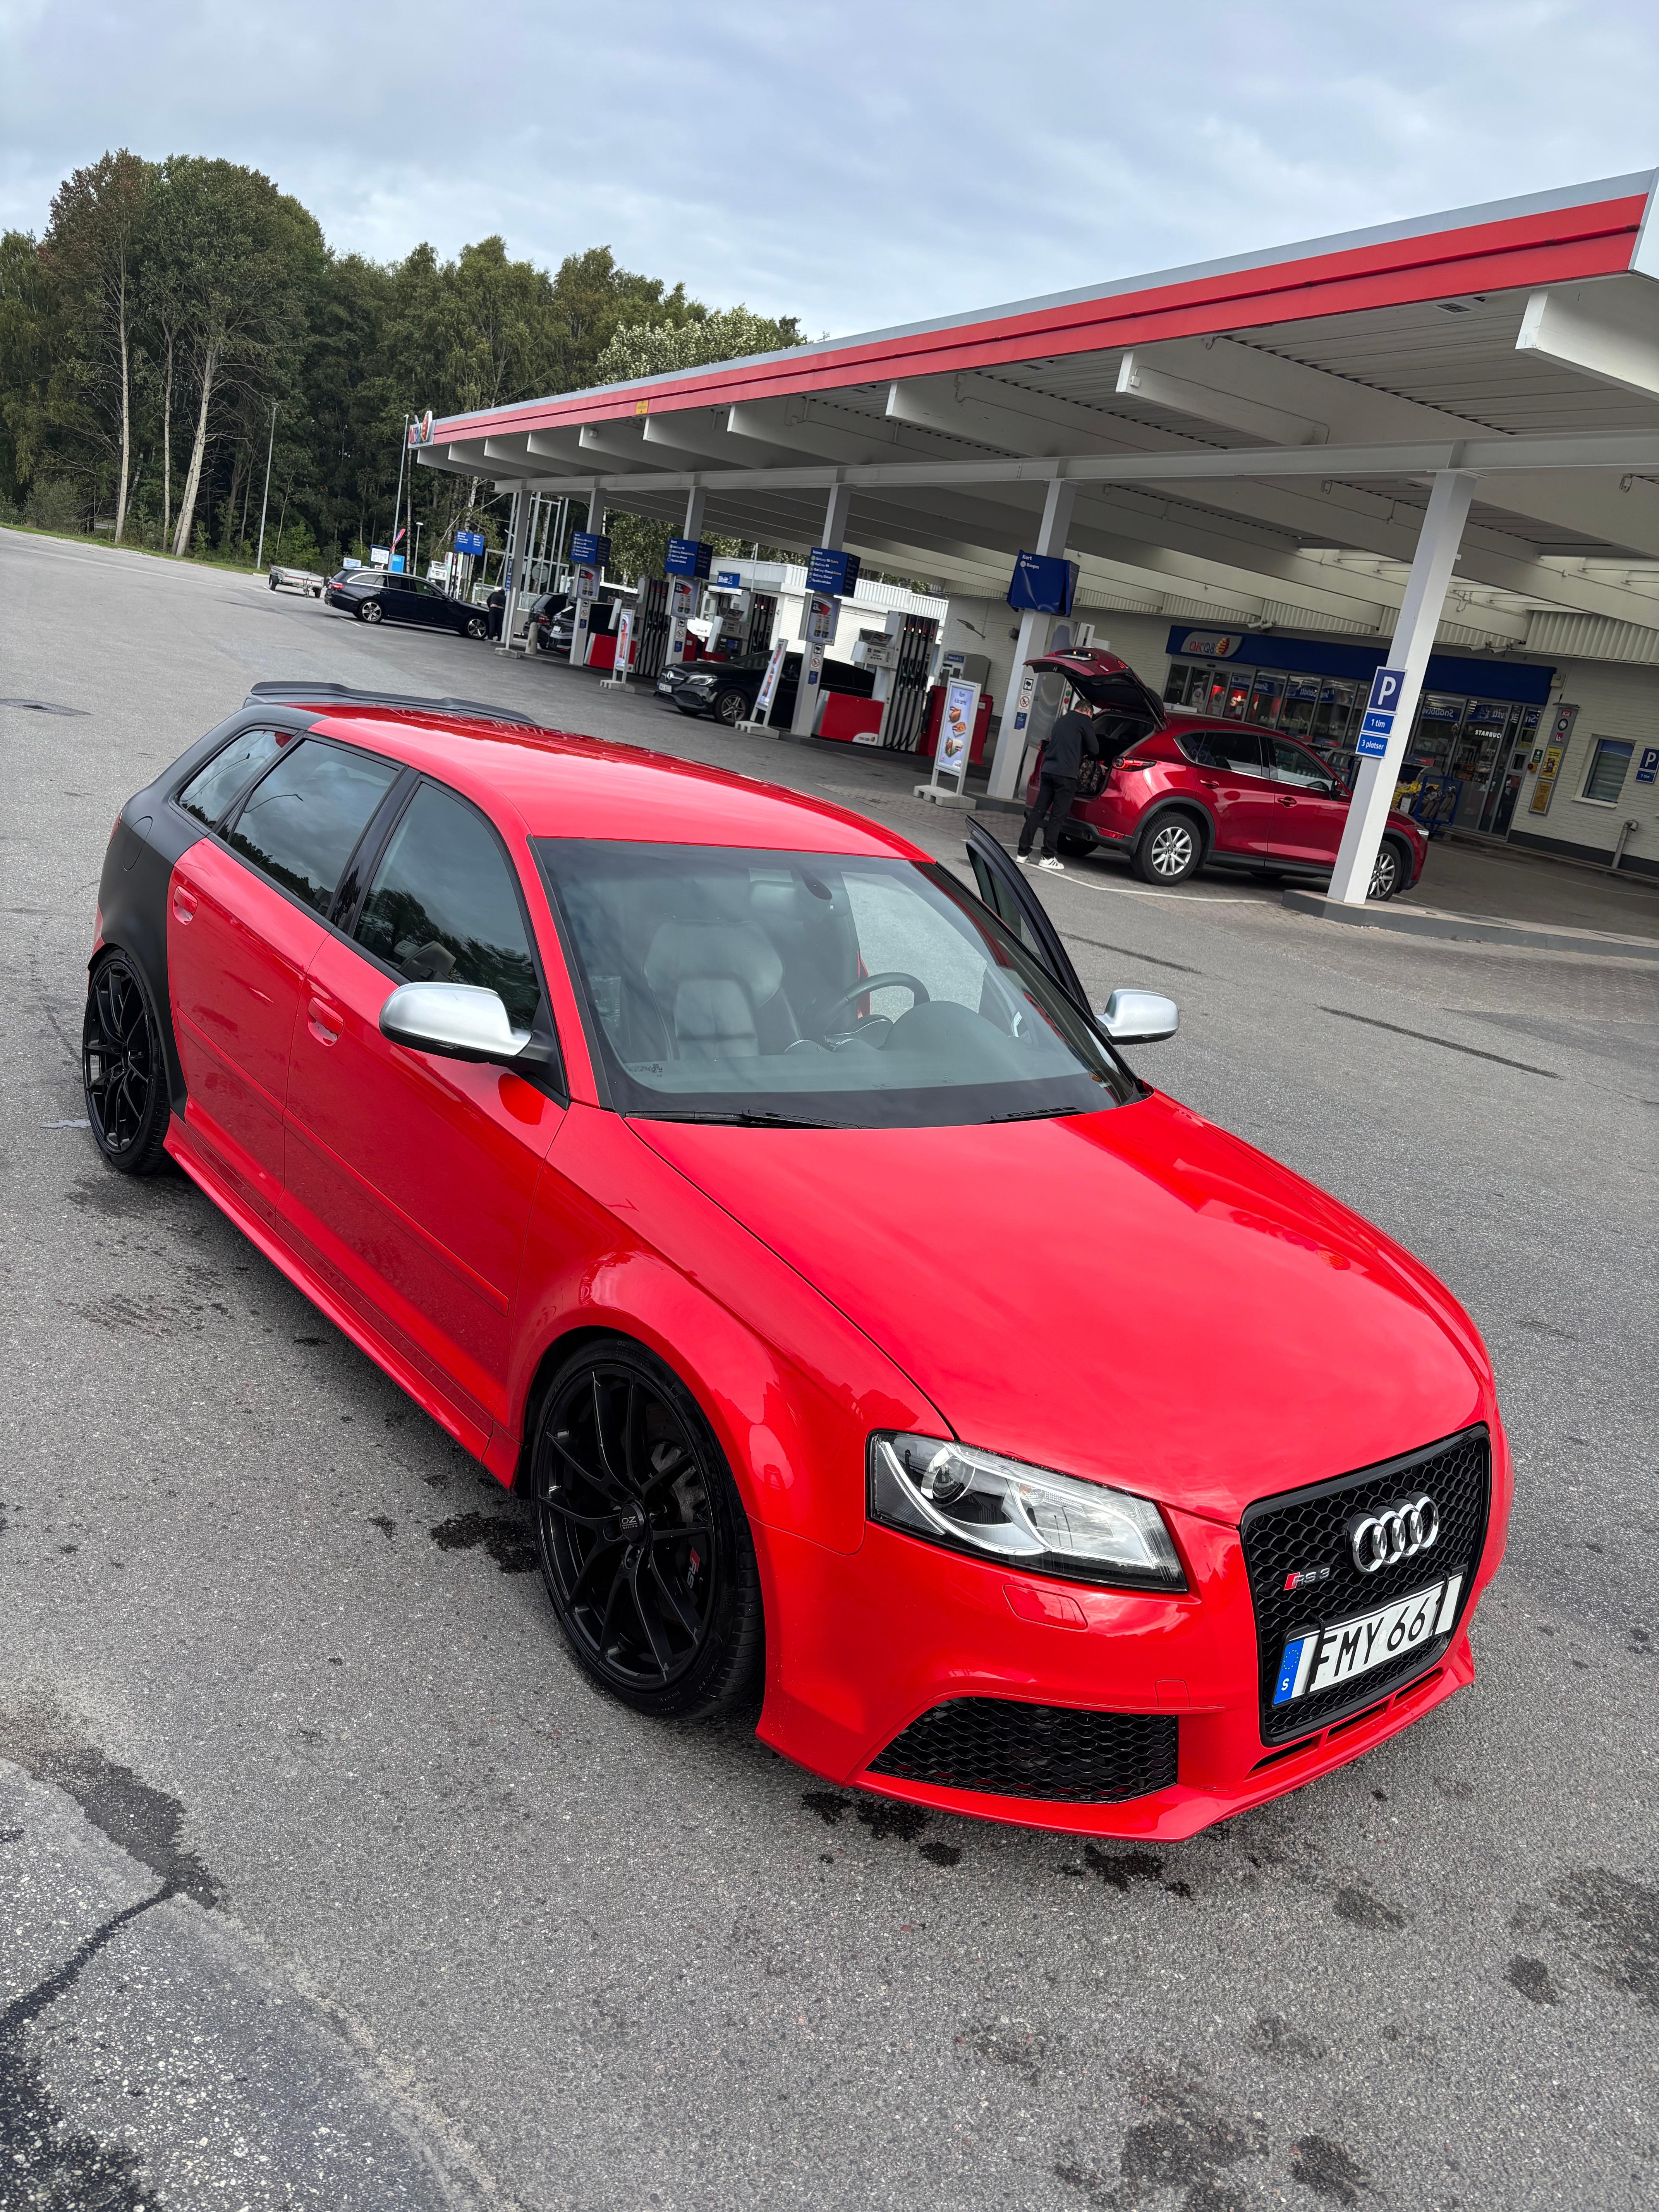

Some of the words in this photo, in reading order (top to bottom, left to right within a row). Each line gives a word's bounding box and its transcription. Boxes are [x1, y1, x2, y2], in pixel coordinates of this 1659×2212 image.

[1189, 641, 1216, 654] OKQ8
[1377, 676, 1396, 705] P
[1375, 720, 1386, 728] tim
[1365, 742, 1384, 750] platser
[1645, 752, 1656, 767] P
[1281, 1677, 1290, 1691] S
